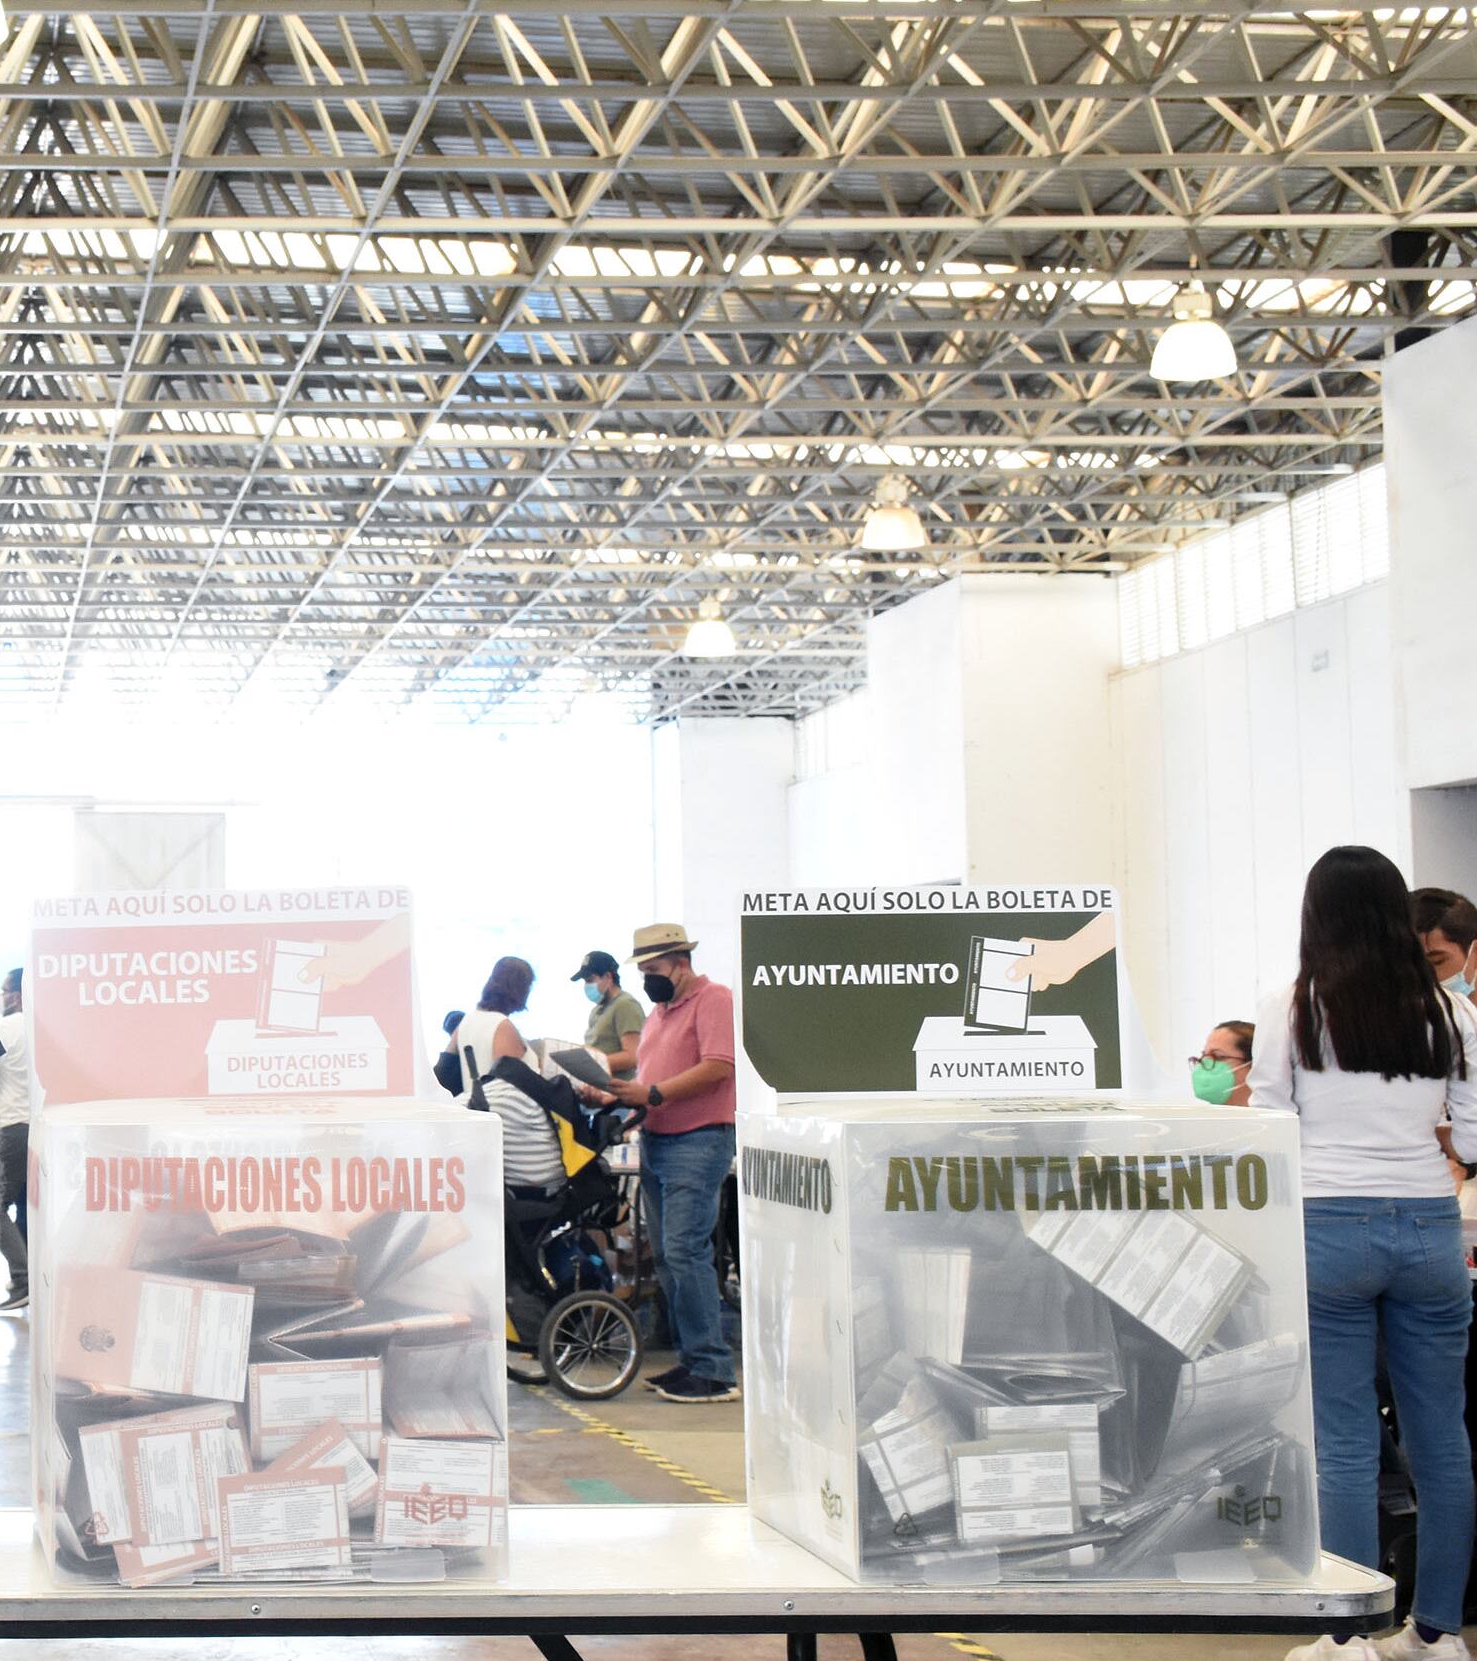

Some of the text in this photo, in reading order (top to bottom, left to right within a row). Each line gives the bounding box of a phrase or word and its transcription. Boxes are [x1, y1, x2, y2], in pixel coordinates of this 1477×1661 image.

[33, 888, 409, 919] META AQUÍ SOLO LA BOLETA DE
[742, 886, 1113, 913] META AQUÍ SOLO LA BOLETA DE
[37, 949, 259, 979] DIPUTACIONES
[752, 963, 960, 987] AYUNTAMIENTO
[78, 979, 210, 1007] LOCALES
[227, 1053, 369, 1073] DIPUTACIONES
[929, 1061, 1085, 1079] AYUNTAMIENTO
[257, 1071, 341, 1090] LOCALES
[84, 1156, 466, 1213] DIPUTACIONES LOCALES
[741, 1146, 833, 1215] AYUNTAMIENTO
[884, 1153, 1269, 1212] AYUNTAMIENTO
[1217, 1495, 1282, 1527] IEEQ
